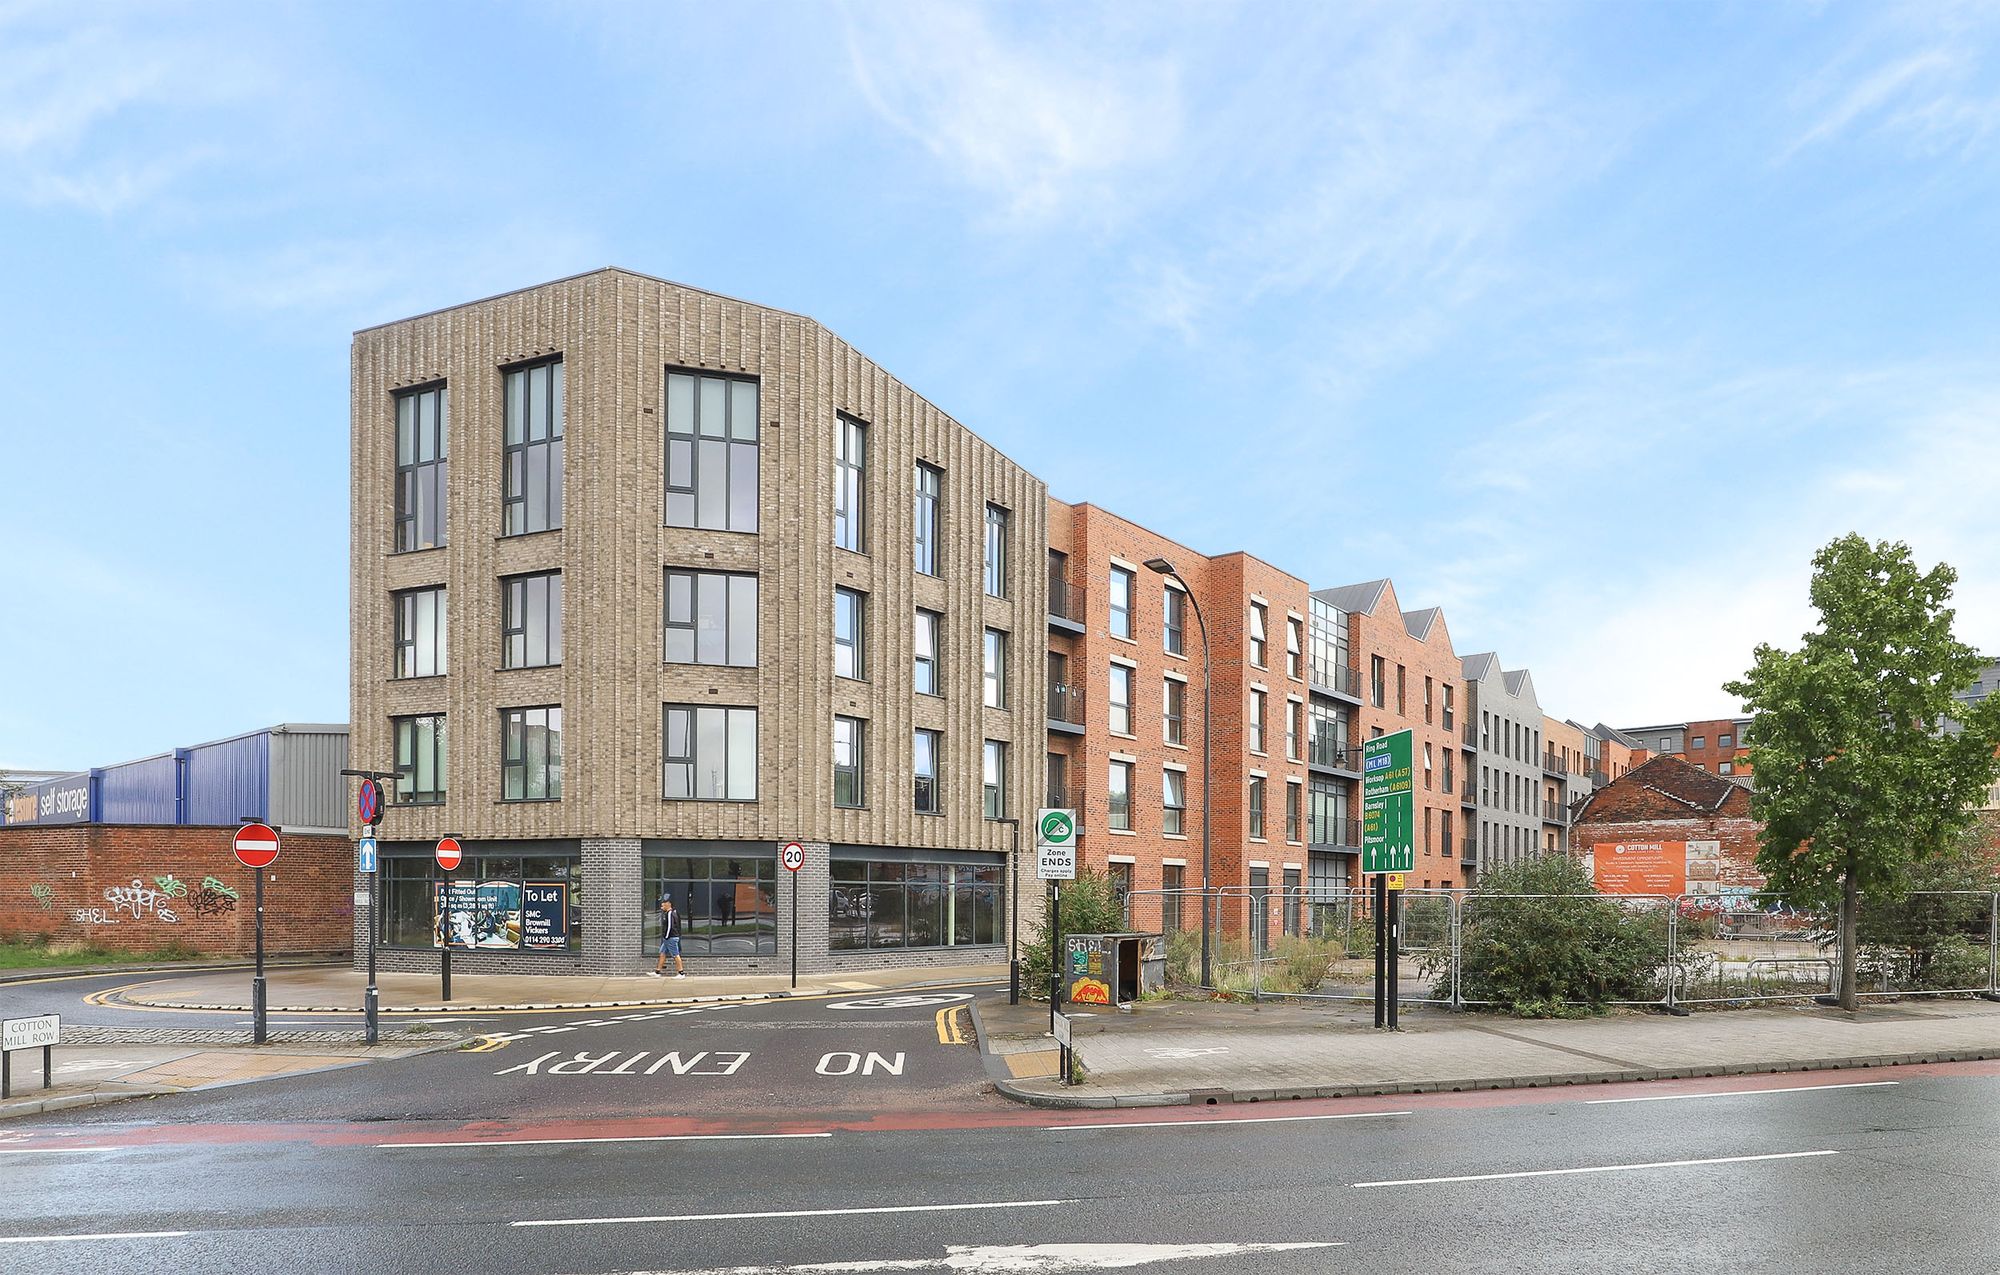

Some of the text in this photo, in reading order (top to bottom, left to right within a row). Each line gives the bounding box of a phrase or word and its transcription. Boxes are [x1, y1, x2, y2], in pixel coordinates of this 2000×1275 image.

[1366, 740, 1388, 754] Ring Road
[1366, 774, 1384, 784] Worksop
[1366, 786, 1389, 796] Rotherham
[41, 787, 55, 817] self
[57, 786, 88, 818] storage
[1365, 801, 1384, 811] Barnsley
[1365, 822, 1379, 833] (A61)
[1365, 835, 1385, 845] Pitsmoor
[786, 851, 802, 863] 20
[1047, 848, 1067, 856] Zone
[1041, 857, 1072, 867] ENDS
[525, 889, 558, 902] To Let
[525, 910, 541, 918] SMC
[525, 918, 551, 927] Brownill
[525, 926, 549, 935] Vickers
[11, 1019, 52, 1033] COTTON
[4, 1031, 55, 1047] MILL ROW
[493, 1051, 906, 1076] NO ENTRY
